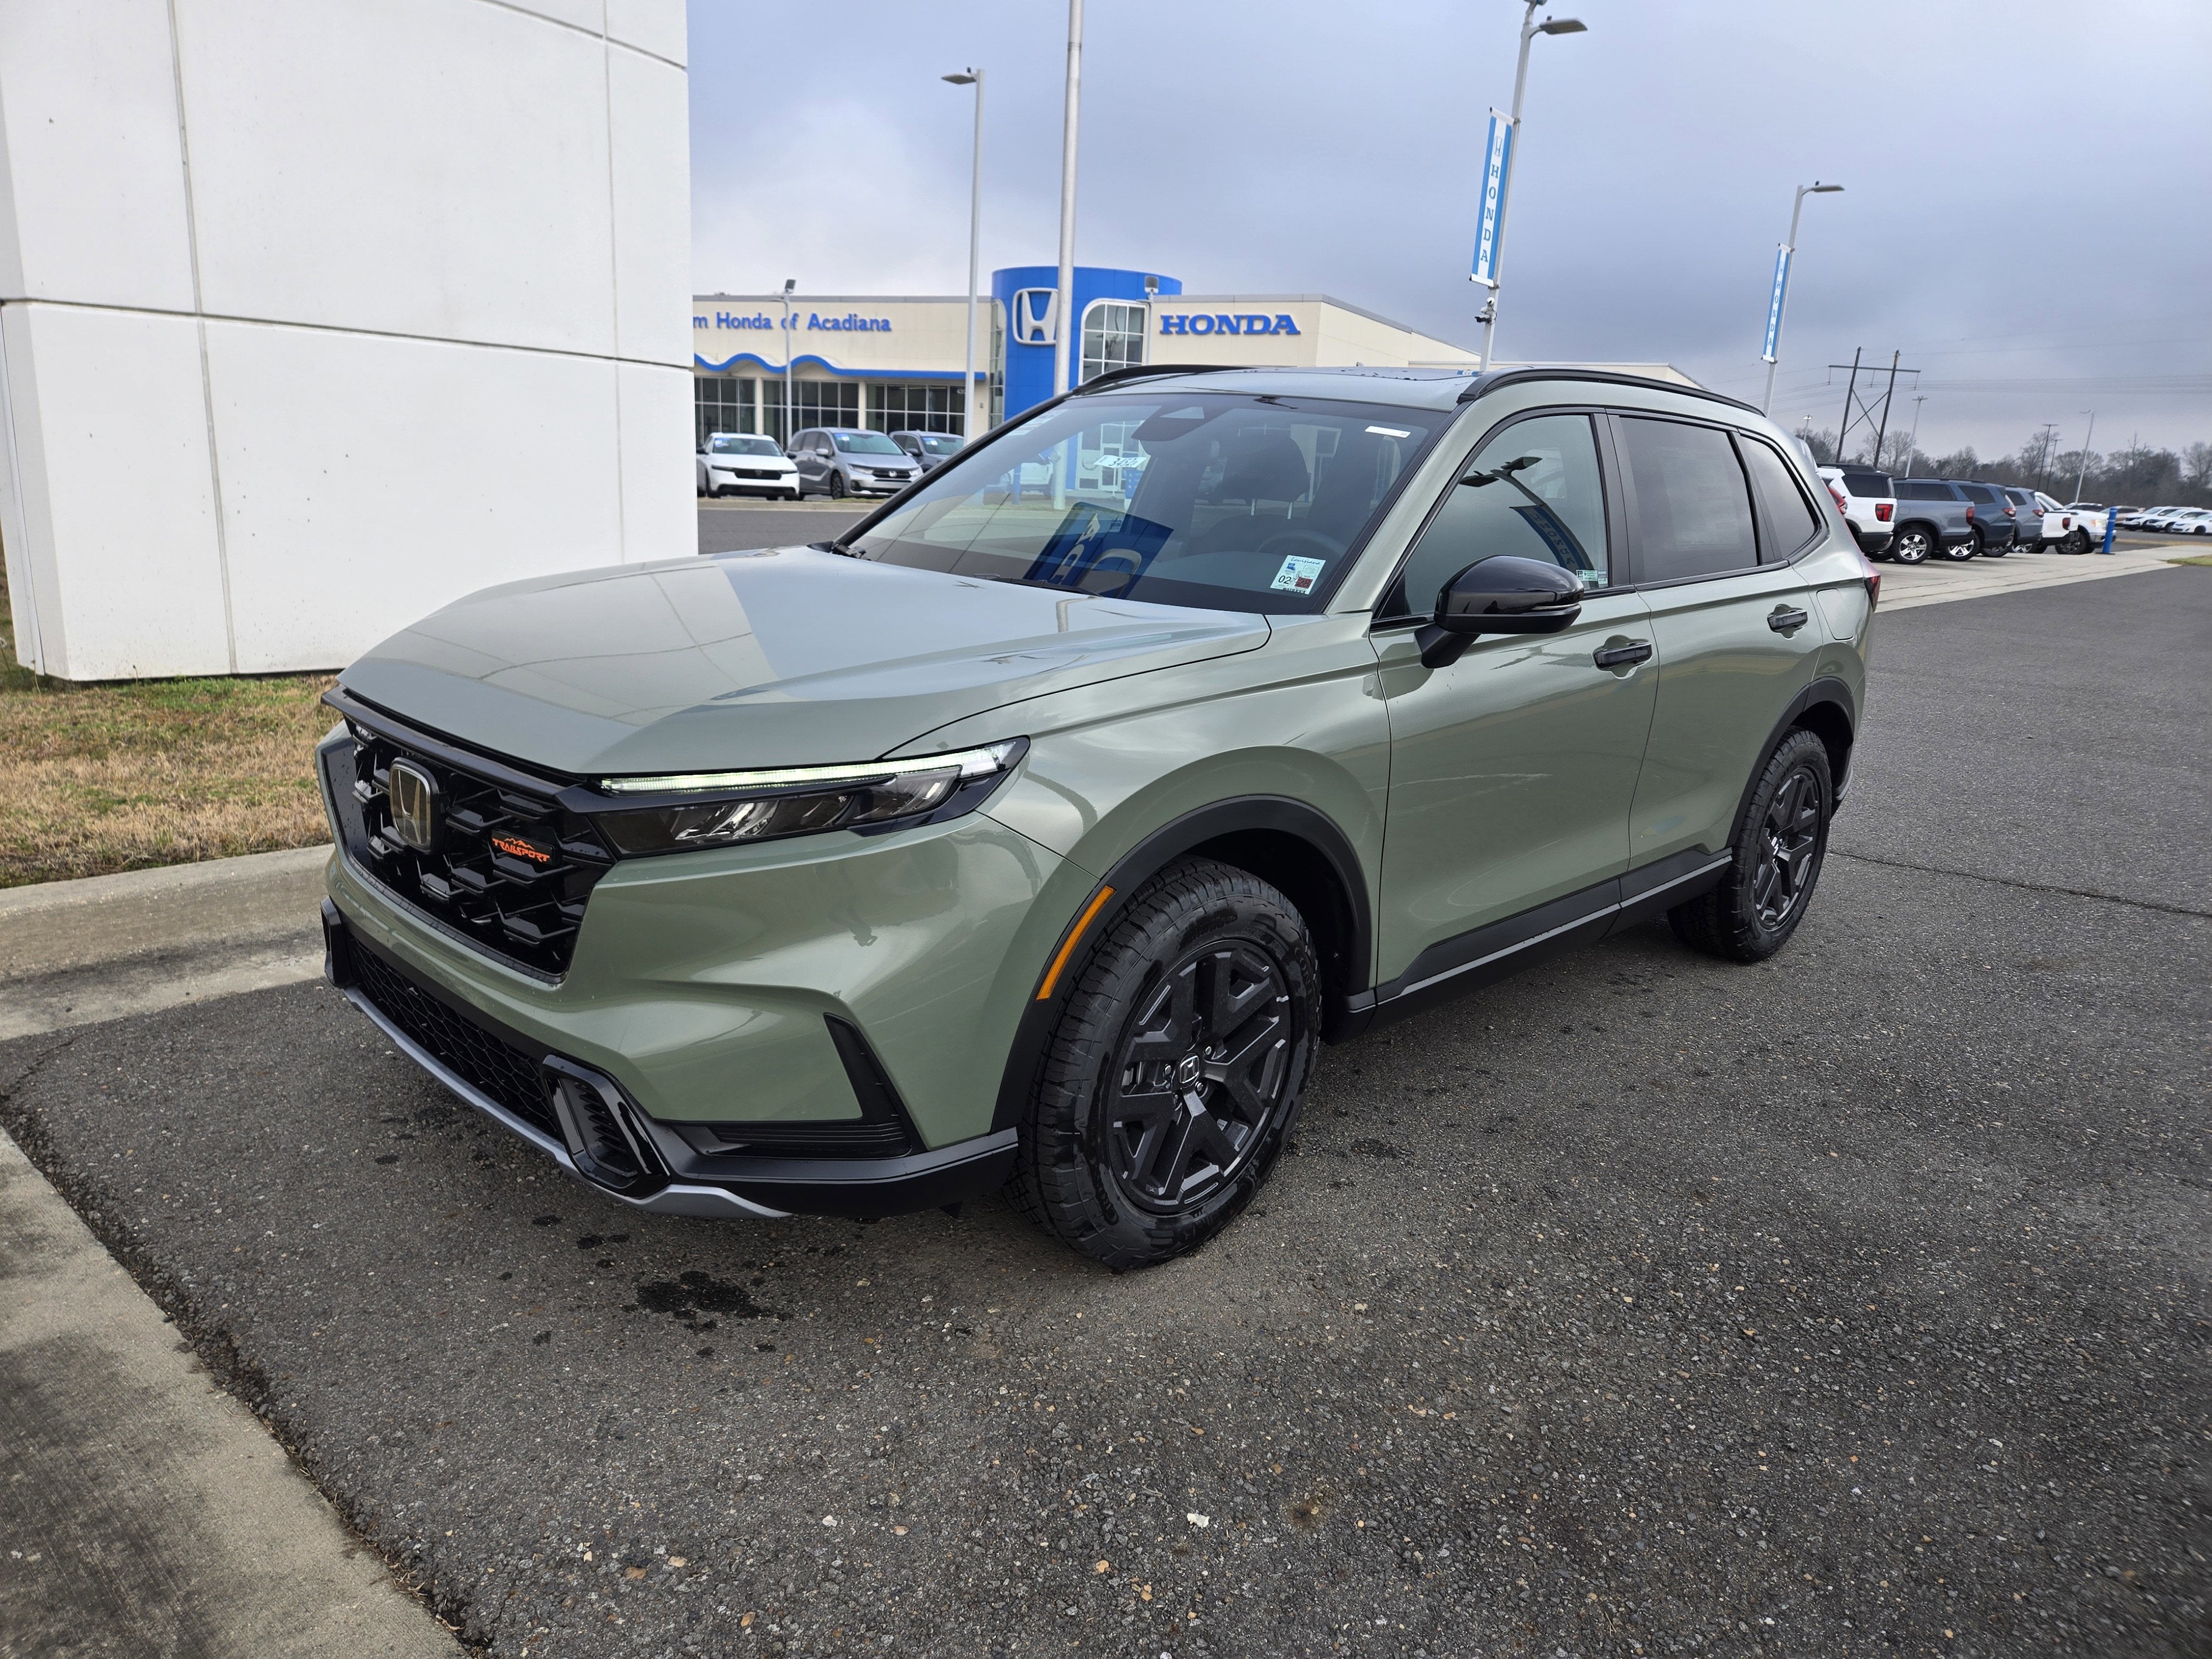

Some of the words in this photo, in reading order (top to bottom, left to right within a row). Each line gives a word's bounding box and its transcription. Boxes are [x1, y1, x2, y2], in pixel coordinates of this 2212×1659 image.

[1480, 164, 1499, 263] HONDA
[717, 312, 772, 330] Honda
[781, 312, 799, 330] of
[807, 313, 892, 331] Acadiana
[1767, 280, 1781, 346] HONDA
[1160, 314, 1301, 335] HONDA
[1279, 575, 1292, 584] 02
[492, 838, 550, 862] TRAILSPORT
